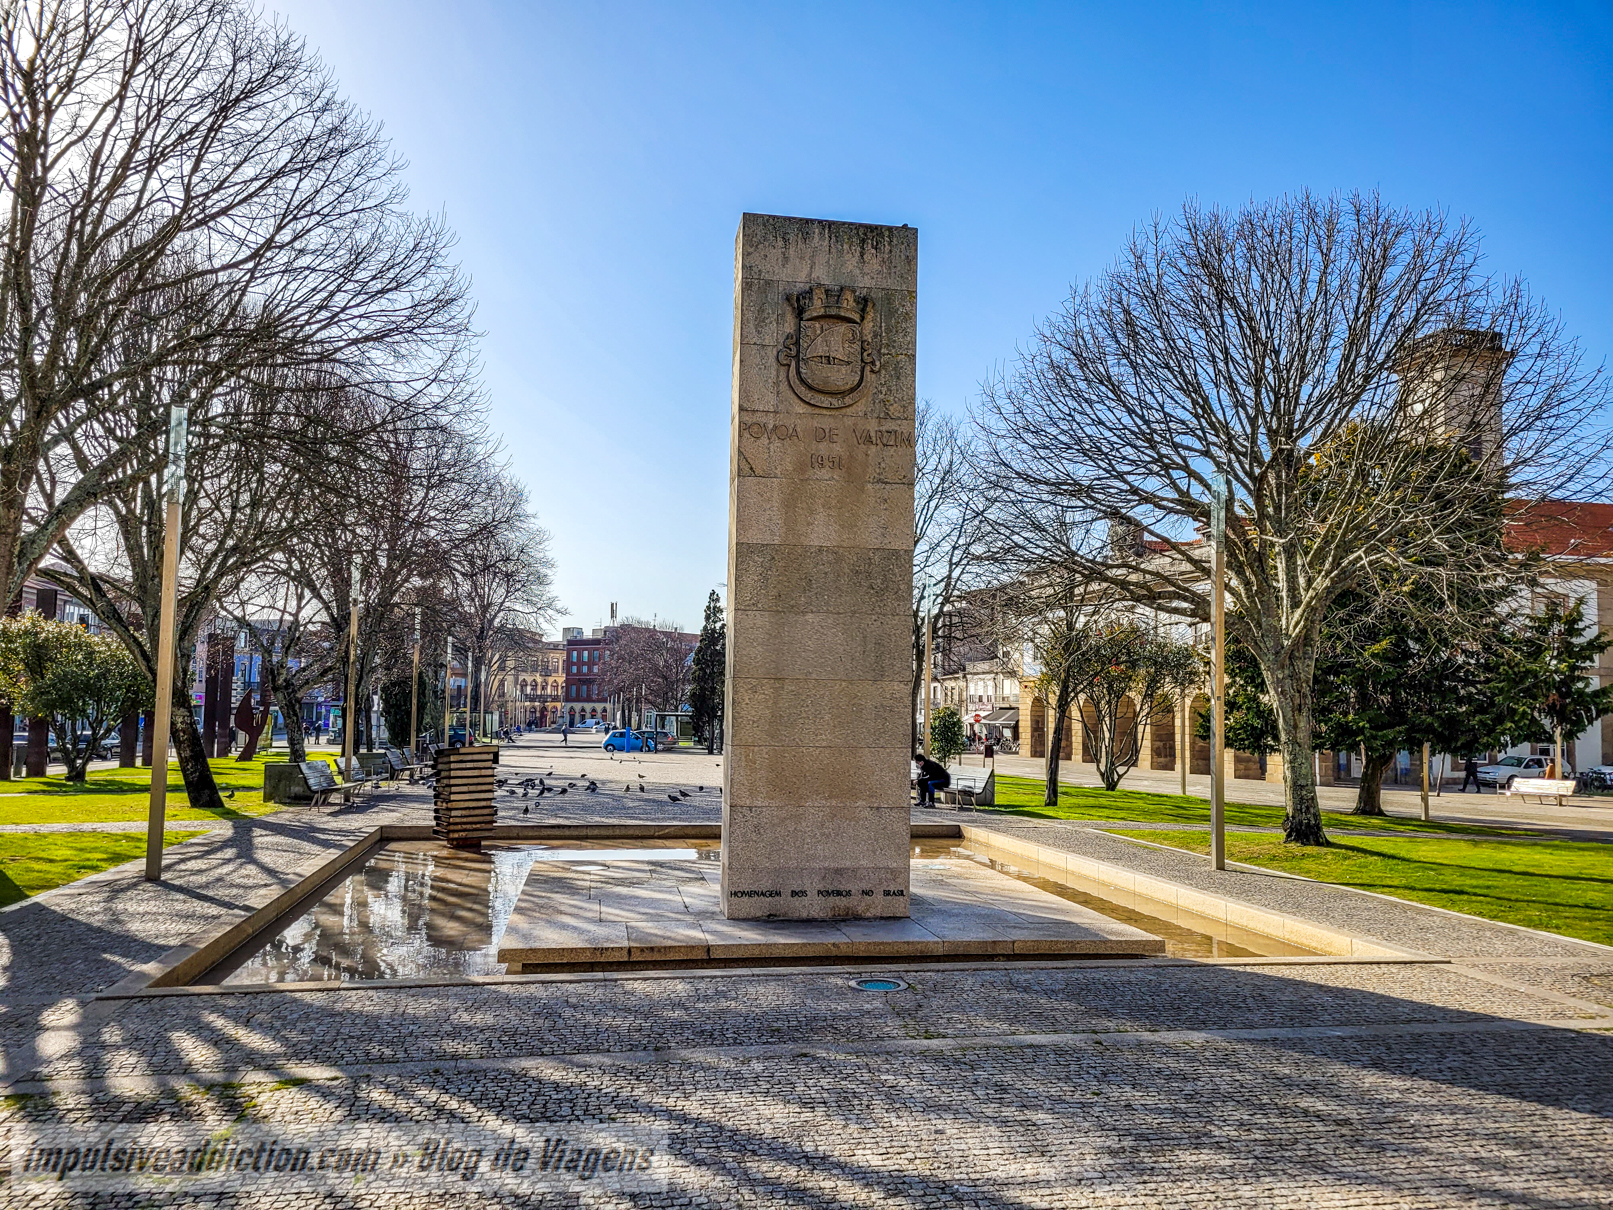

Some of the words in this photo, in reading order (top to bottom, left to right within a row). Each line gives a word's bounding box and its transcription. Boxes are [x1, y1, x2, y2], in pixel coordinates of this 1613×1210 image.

[739, 421, 801, 441] POVOA
[814, 426, 839, 443] DE
[852, 428, 913, 448] VARZIM
[810, 453, 842, 471] 1951
[730, 890, 782, 898] HOMENAGEM
[791, 889, 808, 897] DOS
[817, 889, 852, 897] POVEIROS
[862, 889, 874, 897] NO
[883, 889, 906, 897] BRASIL
